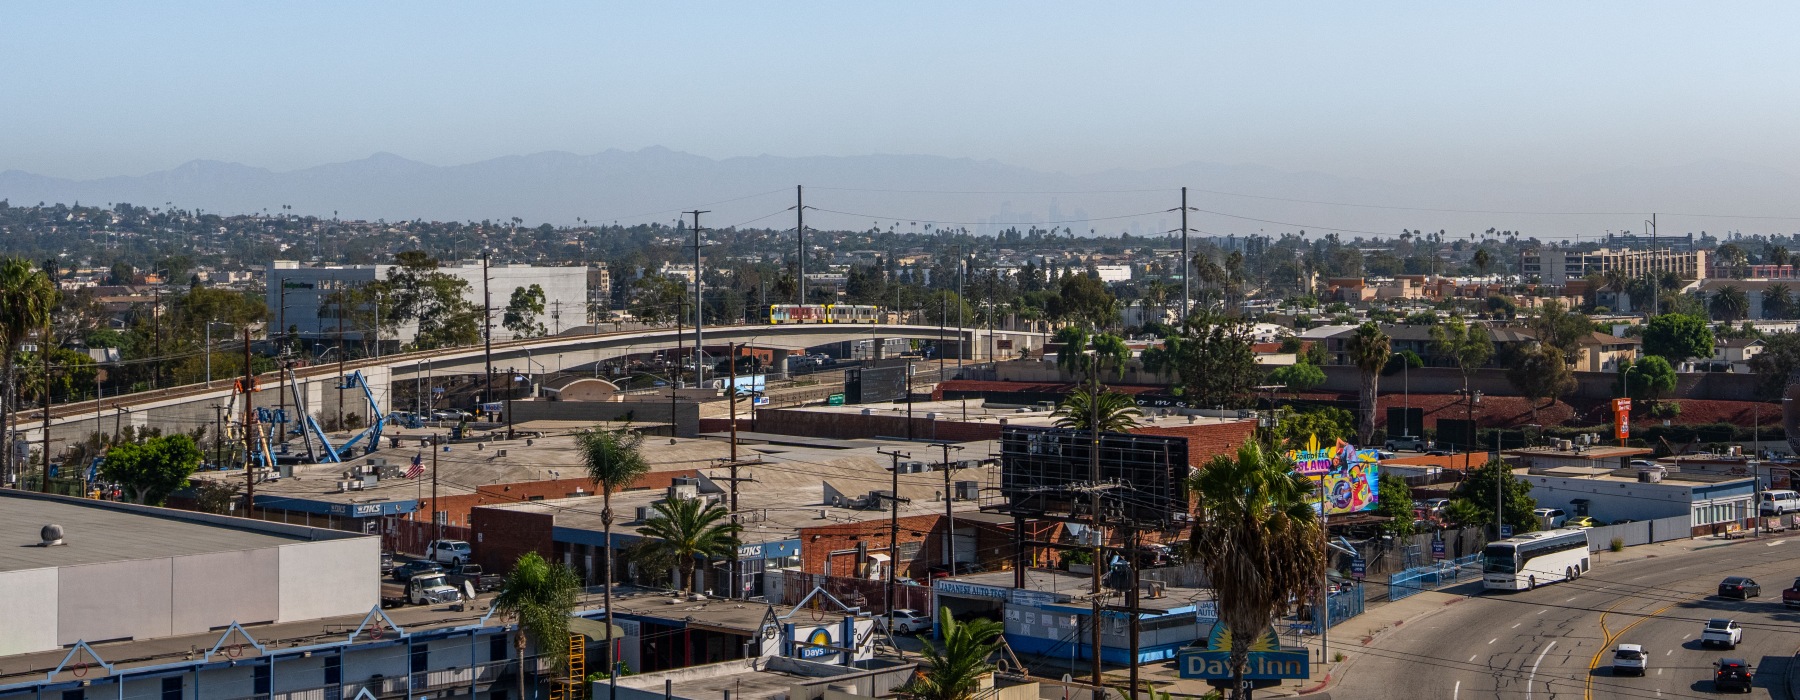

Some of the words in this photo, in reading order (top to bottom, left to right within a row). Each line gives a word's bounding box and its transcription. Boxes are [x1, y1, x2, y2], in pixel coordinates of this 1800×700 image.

[743, 545, 762, 556] DKS
[940, 582, 971, 595] JAPANESE
[804, 648, 824, 657] Days
[1258, 657, 1301, 675] Inn
